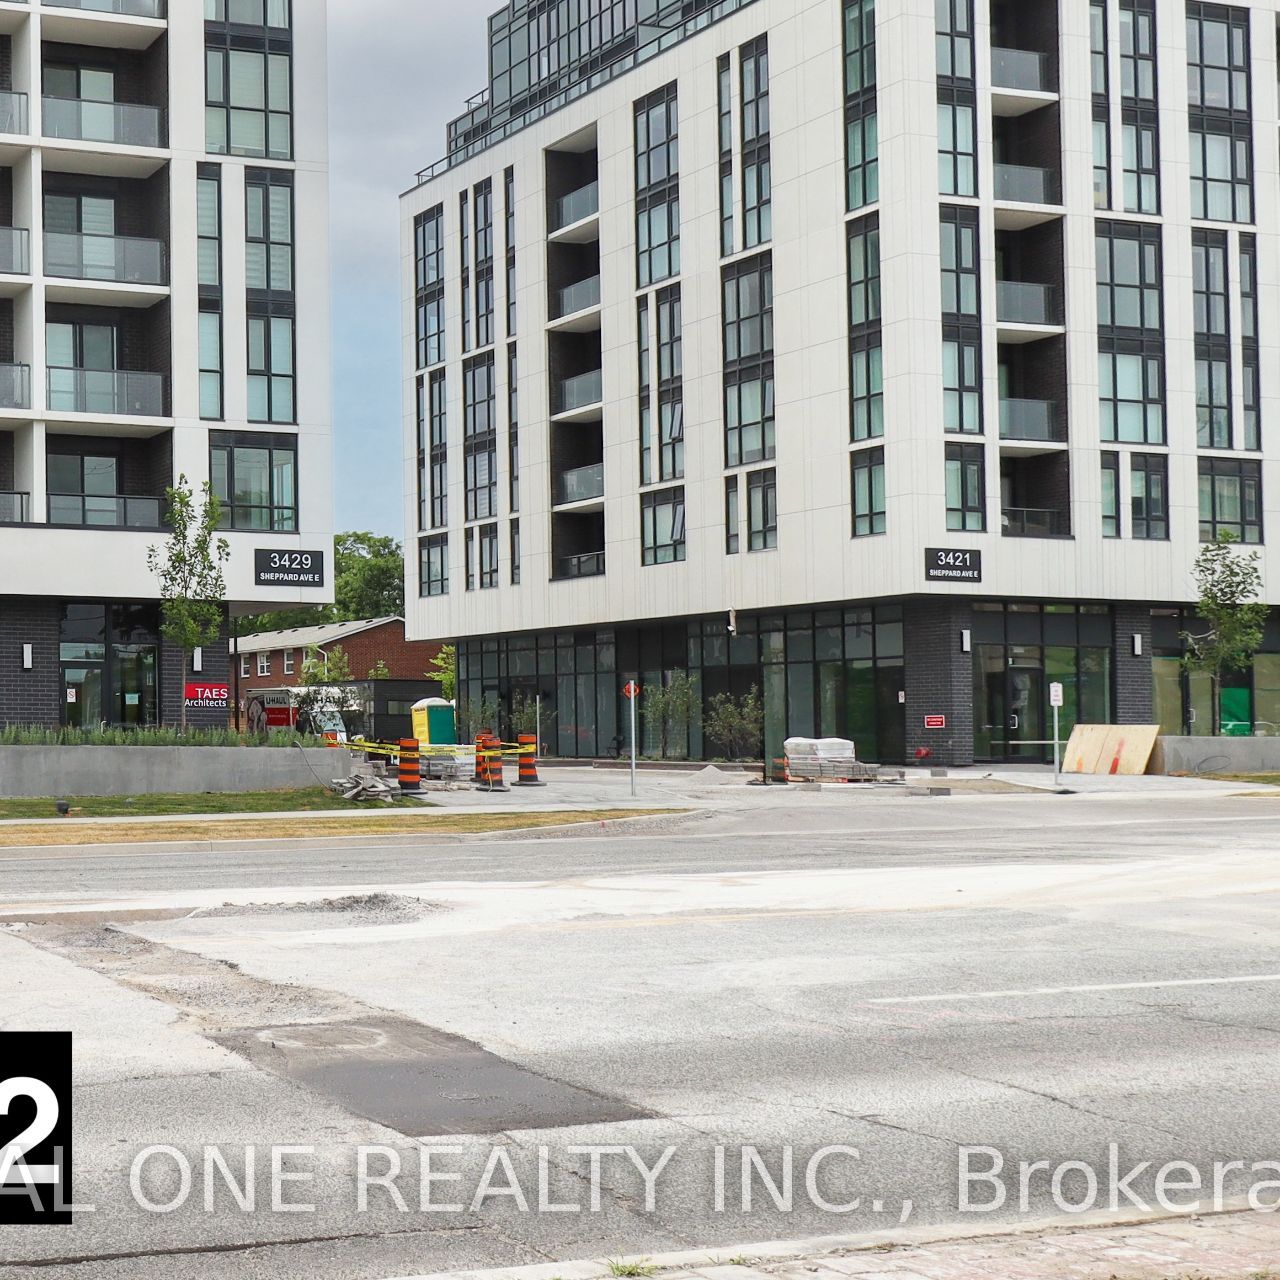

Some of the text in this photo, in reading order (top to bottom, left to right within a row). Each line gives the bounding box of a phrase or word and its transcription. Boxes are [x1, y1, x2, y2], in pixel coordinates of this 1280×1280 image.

[270, 553, 312, 569] 3429
[937, 551, 970, 566] 3421
[260, 572, 320, 582] SHEPPARD AVE E
[929, 569, 961, 577] SHEPPARD
[195, 688, 228, 699] TAES
[184, 699, 227, 707] Architects
